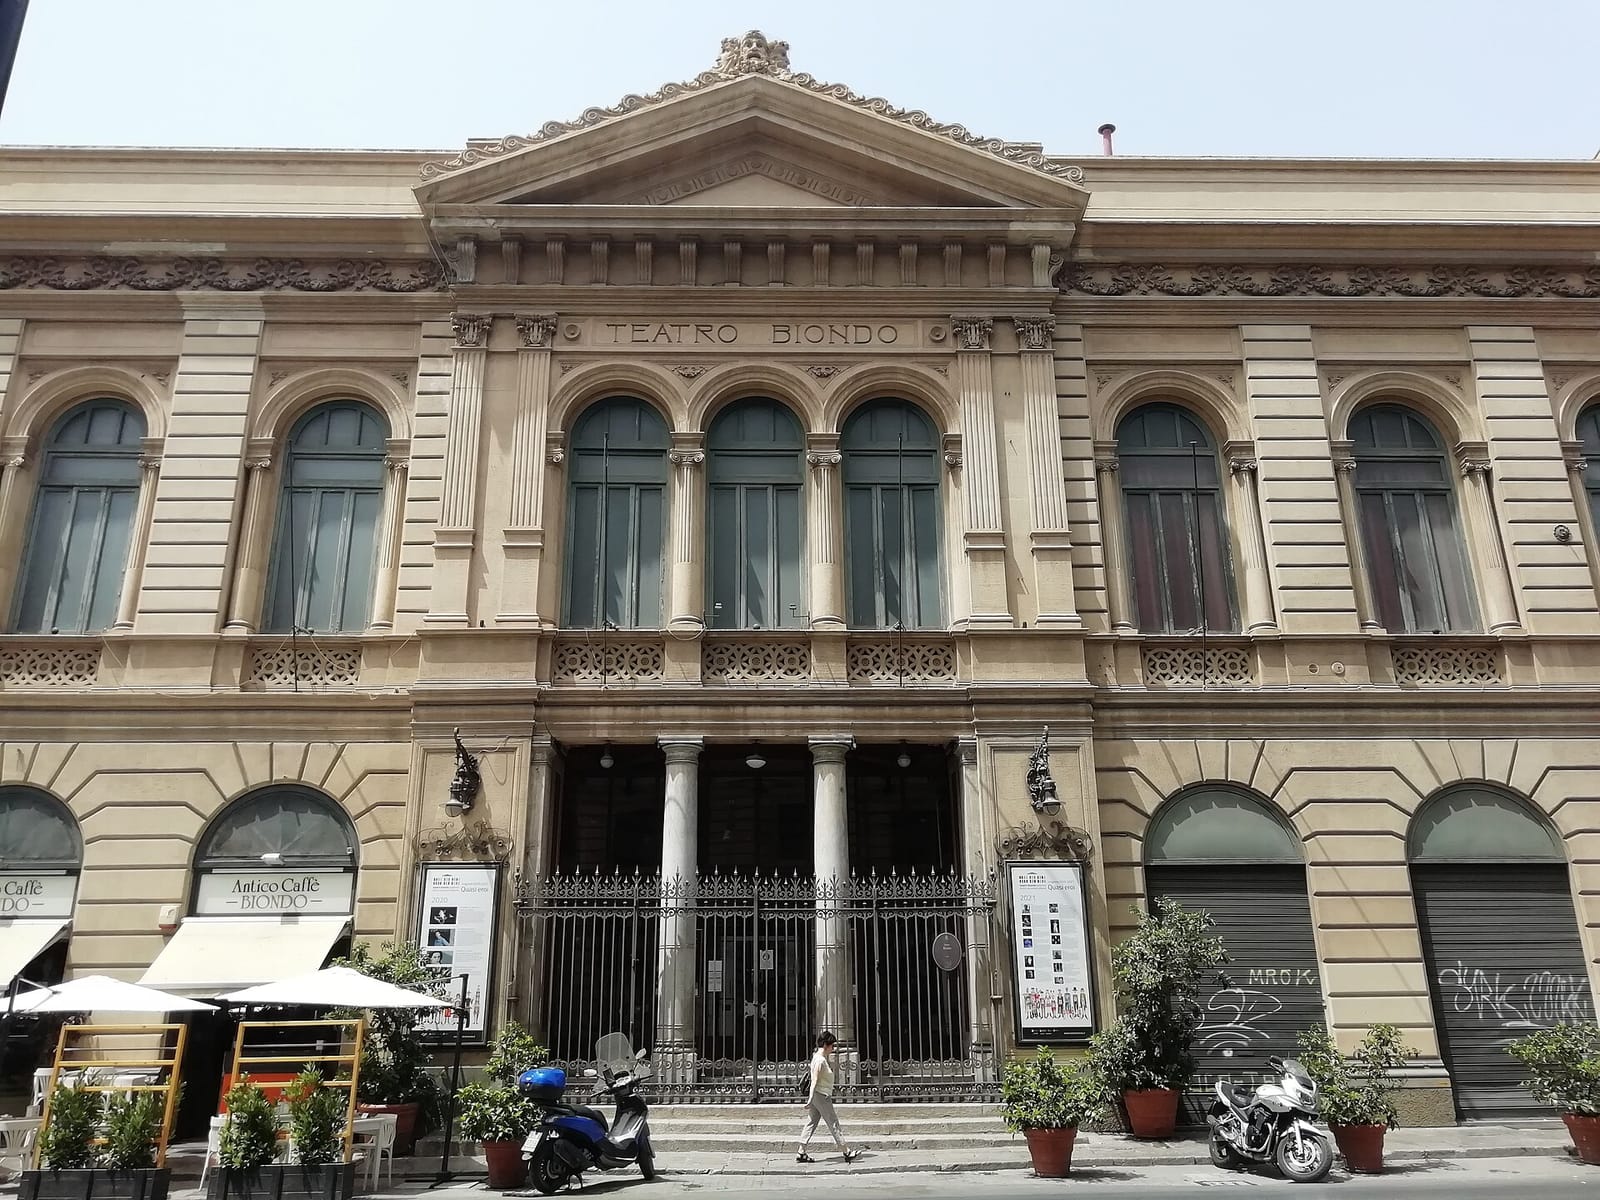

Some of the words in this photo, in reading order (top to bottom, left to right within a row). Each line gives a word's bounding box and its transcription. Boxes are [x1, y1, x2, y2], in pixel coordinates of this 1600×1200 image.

[606, 323, 739, 344] TEATRO
[771, 324, 899, 345] BIONDO
[4, 879, 43, 896] Caffè
[231, 879, 279, 894] Antico
[281, 876, 320, 893] Caffè
[240, 894, 308, 910] BIONDO
